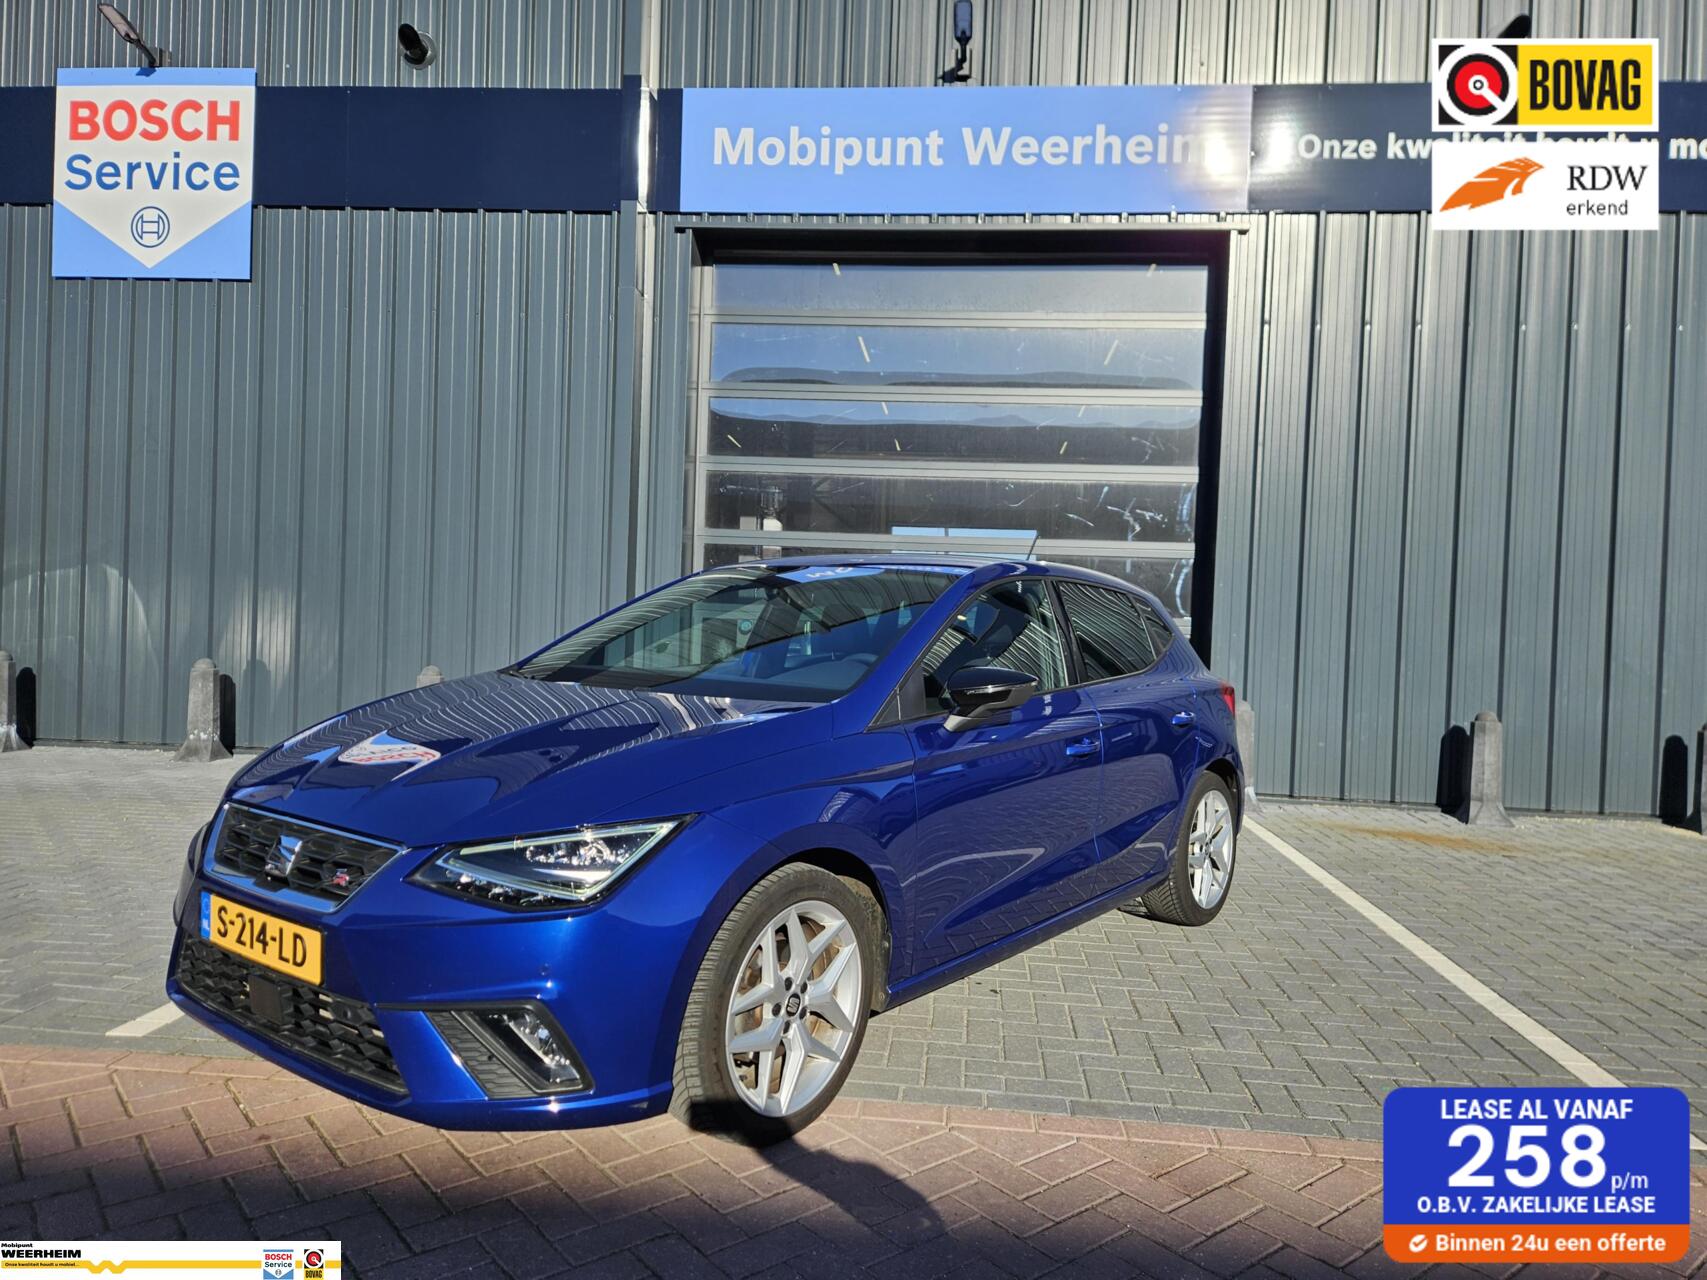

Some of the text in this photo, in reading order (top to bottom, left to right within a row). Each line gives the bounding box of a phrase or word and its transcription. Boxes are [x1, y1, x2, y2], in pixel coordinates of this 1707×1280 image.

[69, 99, 240, 141] BOSCH
[713, 125, 943, 174] Mobipunt
[1297, 134, 1377, 160] Onze
[64, 151, 240, 191] Service
[217, 905, 307, 967] S-214-LD
